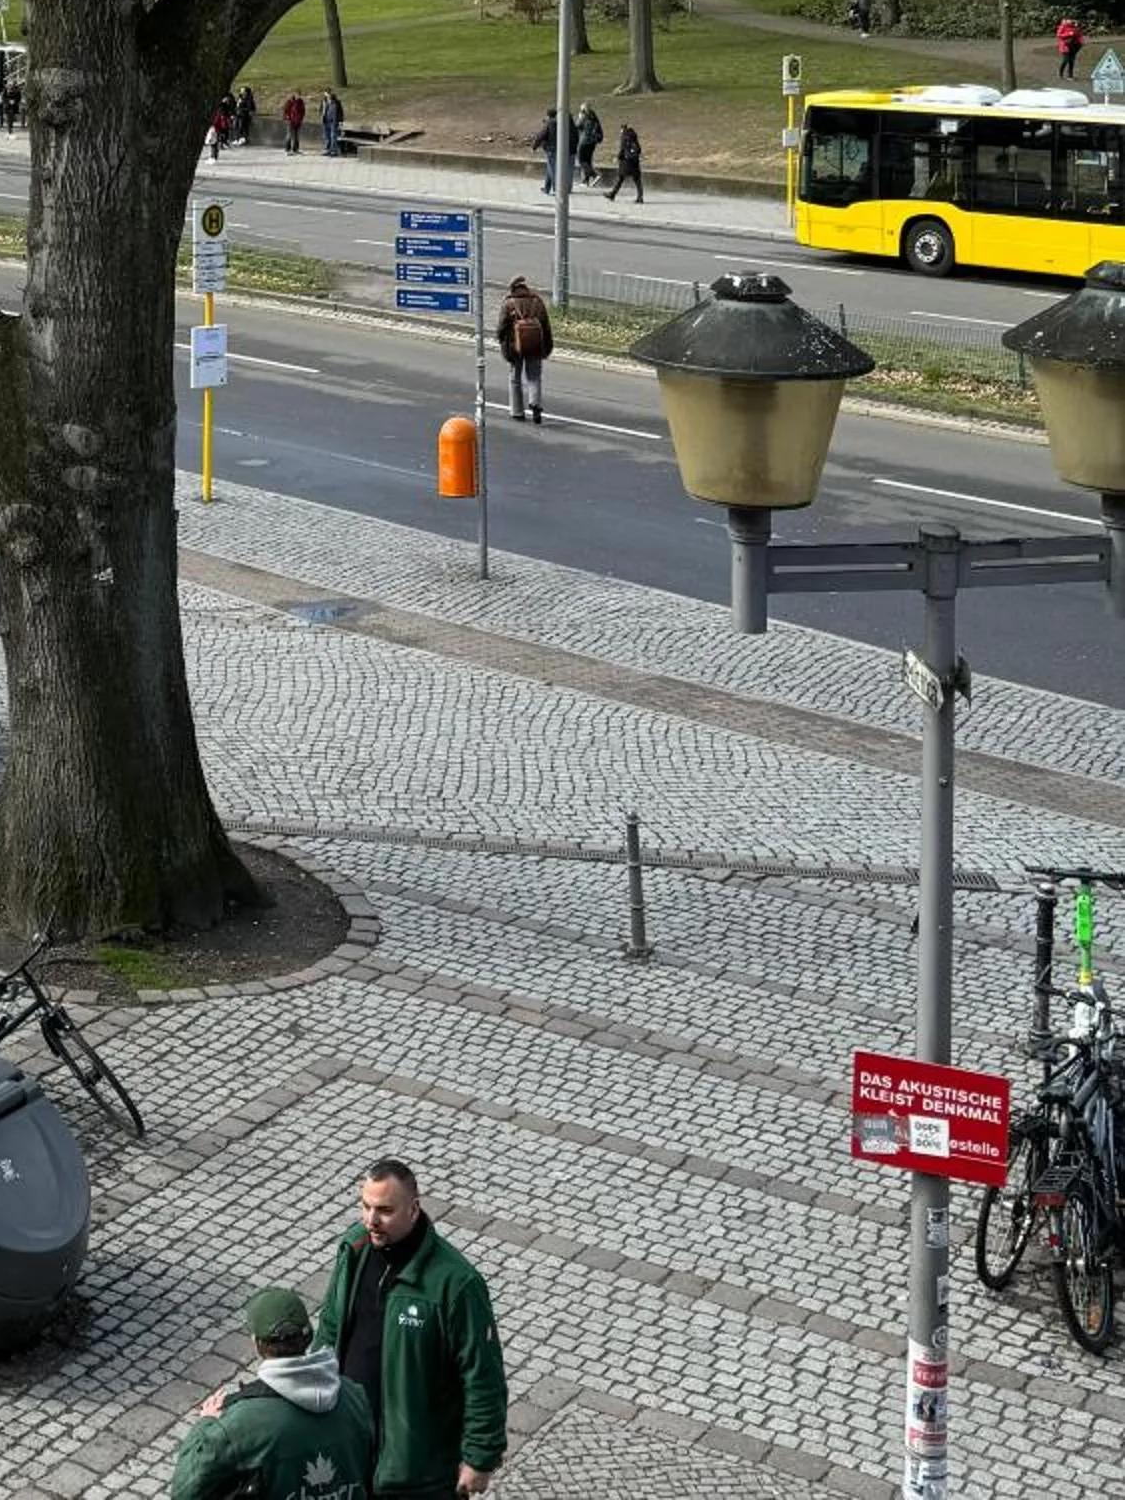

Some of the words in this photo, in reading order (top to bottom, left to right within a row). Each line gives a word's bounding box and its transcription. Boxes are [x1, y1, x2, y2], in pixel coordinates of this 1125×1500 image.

[860, 1072, 892, 1088] DAS
[898, 1079, 1002, 1109] AKUSTISCHE
[860, 1086, 914, 1107] KLEIST
[922, 1097, 1002, 1124] DENKMAL
[949, 1139, 1000, 1157] estelle
